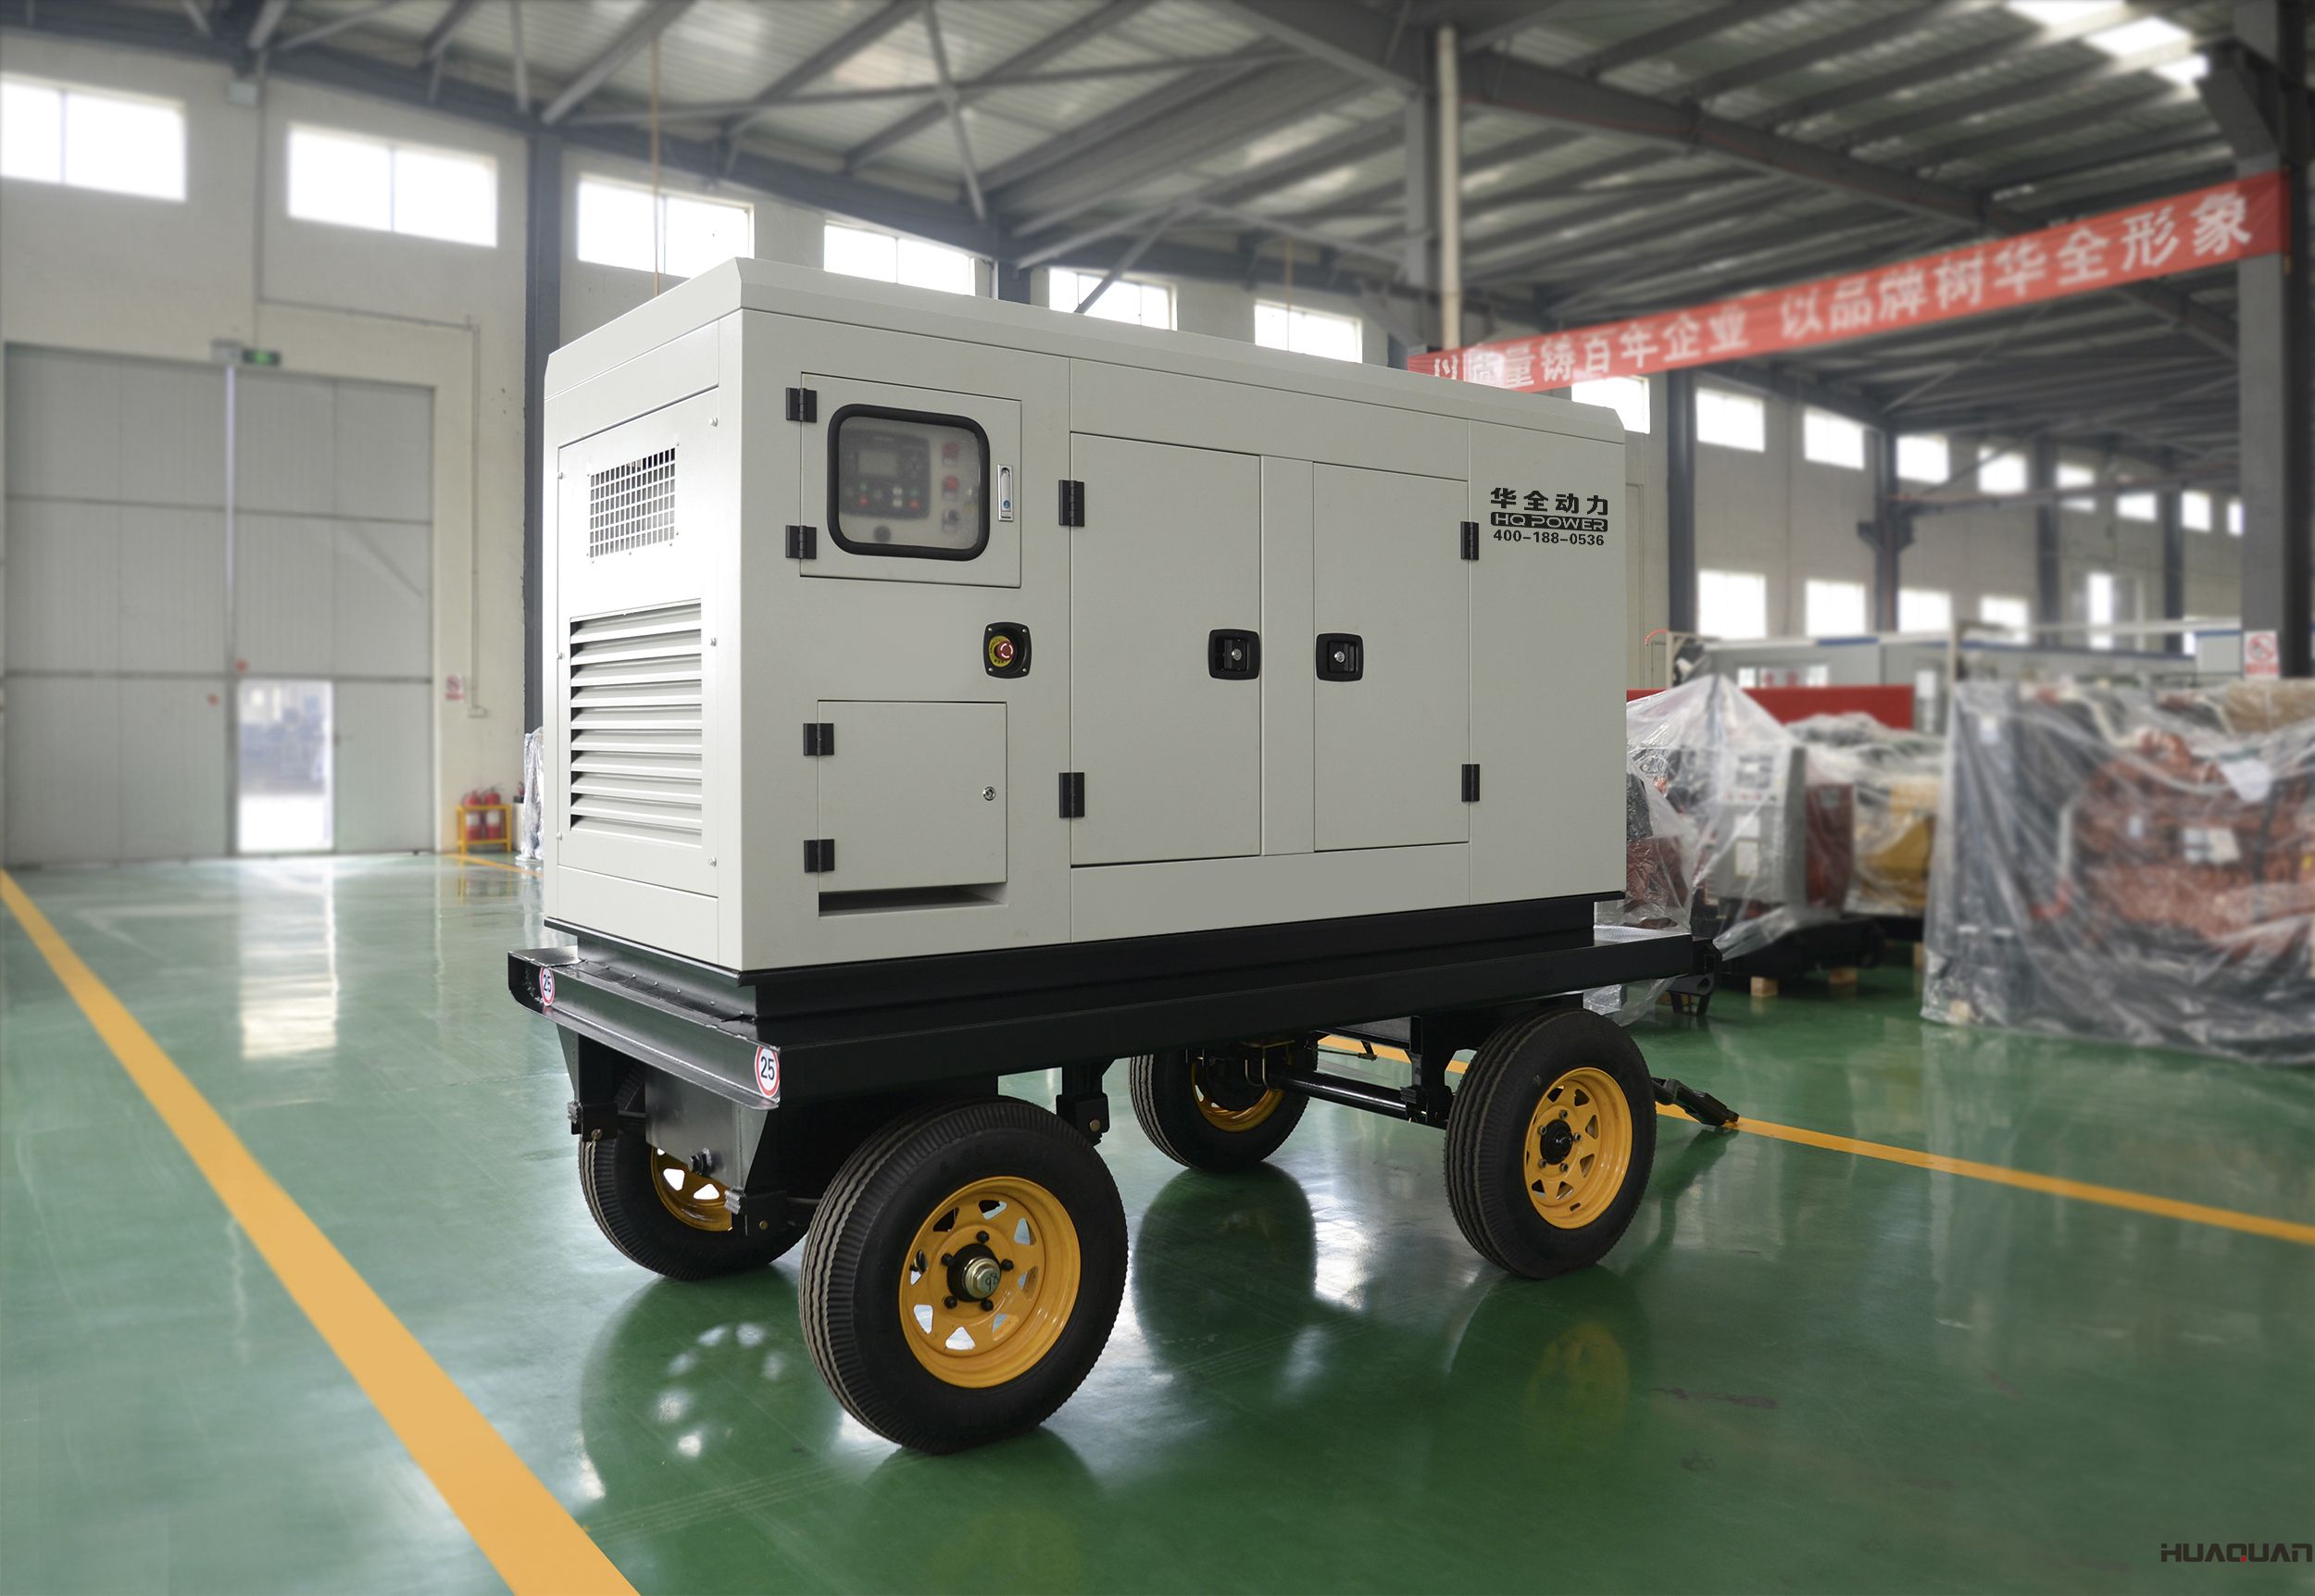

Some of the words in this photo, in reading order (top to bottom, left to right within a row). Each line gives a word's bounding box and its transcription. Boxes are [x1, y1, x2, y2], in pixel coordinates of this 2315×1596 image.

[1780, 192, 2252, 339] 以品牌树华全形象
[1490, 487, 1608, 516] 华全动力
[1495, 513, 1526, 527] HQ
[1531, 515, 1606, 531] POWER
[1493, 530, 1605, 546] 400-188-0536
[544, 974, 552, 992] 25
[760, 1056, 775, 1080] 25
